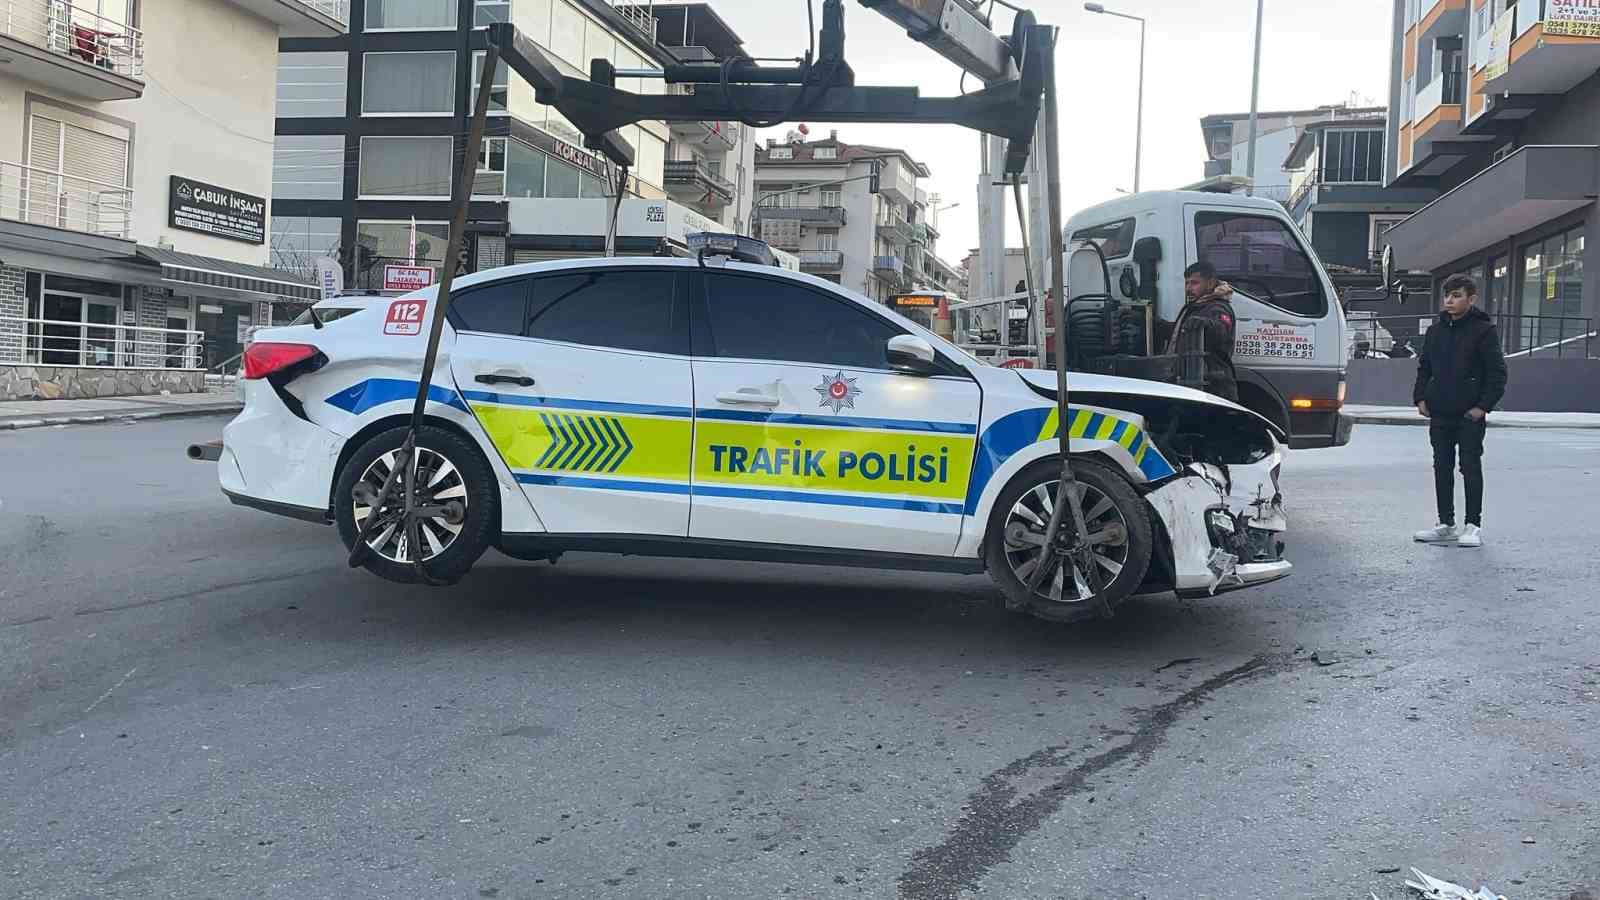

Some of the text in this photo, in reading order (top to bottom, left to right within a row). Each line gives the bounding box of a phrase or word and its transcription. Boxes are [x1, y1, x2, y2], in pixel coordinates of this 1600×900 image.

[554, 140, 595, 170] KÖKSAL
[193, 187, 227, 206] ÇABUK
[230, 194, 264, 215] İNŞAAT
[394, 303, 420, 321] 112
[1236, 340, 1261, 348] 0538
[1242, 334, 1259, 342] OTO
[1236, 347, 1260, 355] 0258
[1286, 349, 1298, 357] 55
[709, 439, 948, 483] TRAFİK POLİSİ
